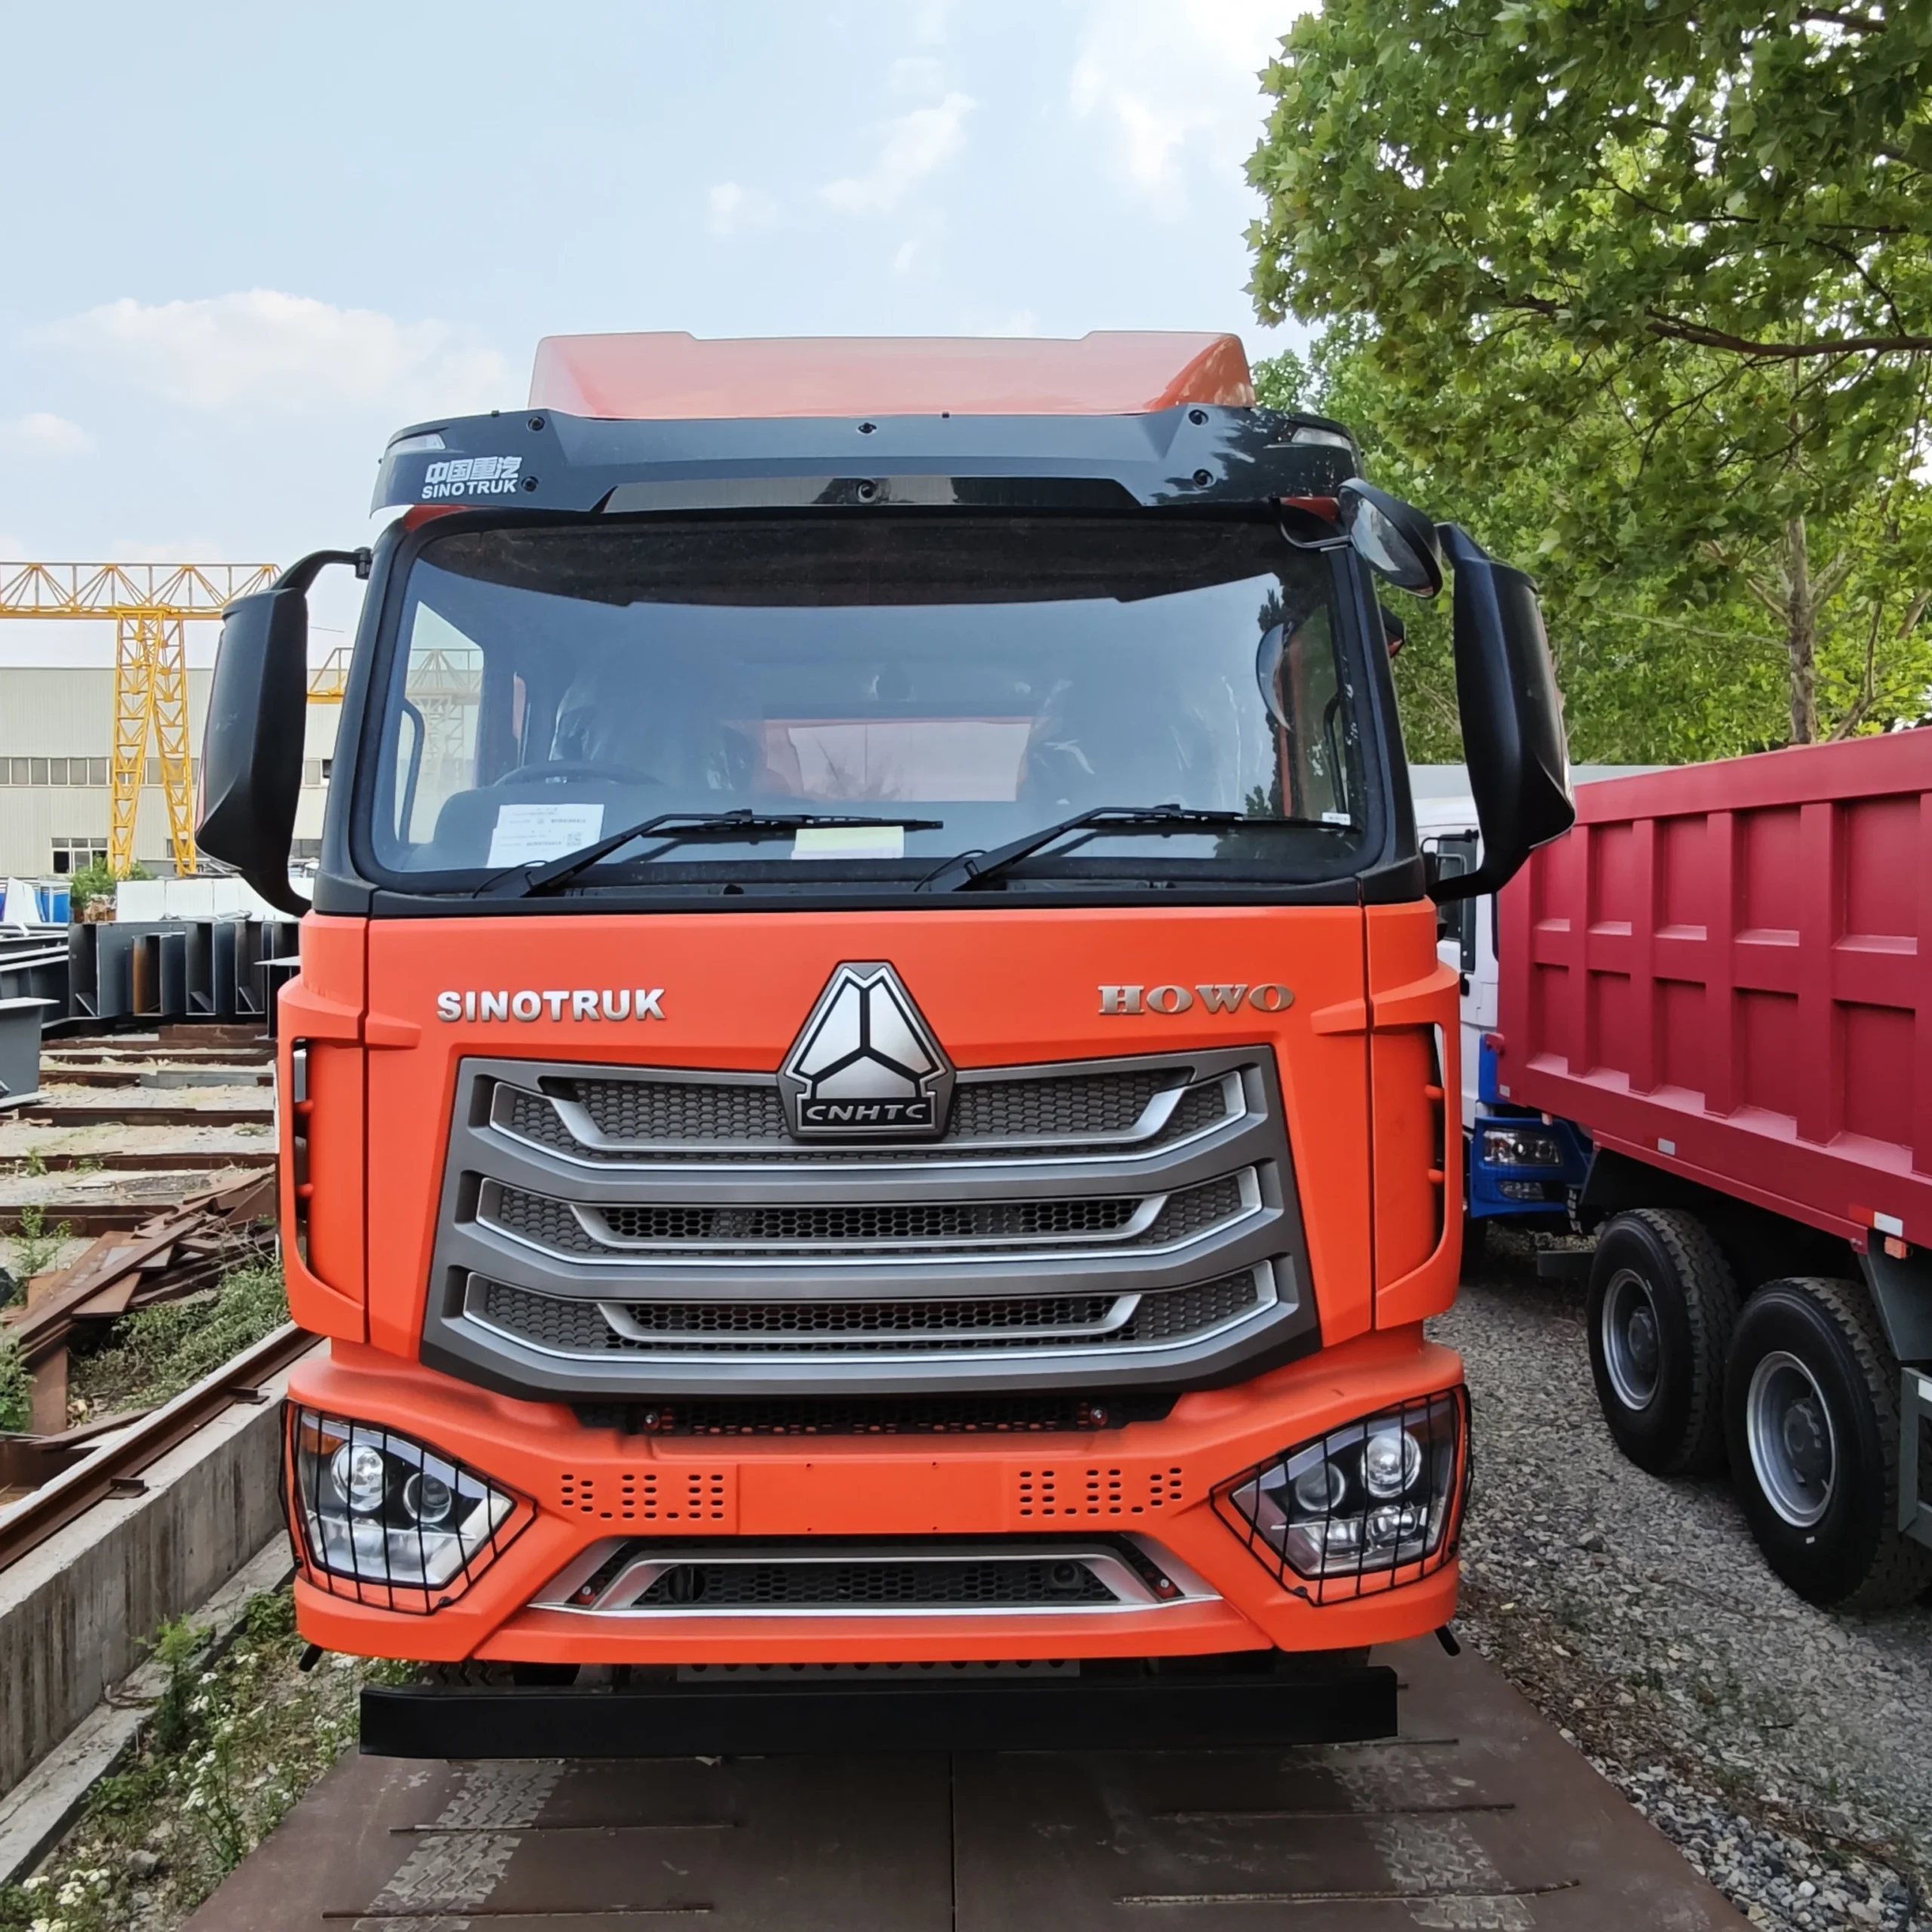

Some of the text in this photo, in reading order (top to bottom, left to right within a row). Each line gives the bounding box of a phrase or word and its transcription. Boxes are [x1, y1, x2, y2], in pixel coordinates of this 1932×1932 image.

[425, 456, 522, 484] 中国重汽
[421, 479, 518, 499] SINOTRUK
[436, 989, 666, 1022] SINOTRUK
[1098, 983, 1296, 1014] HOWO
[806, 1103, 927, 1121] CNHTC
